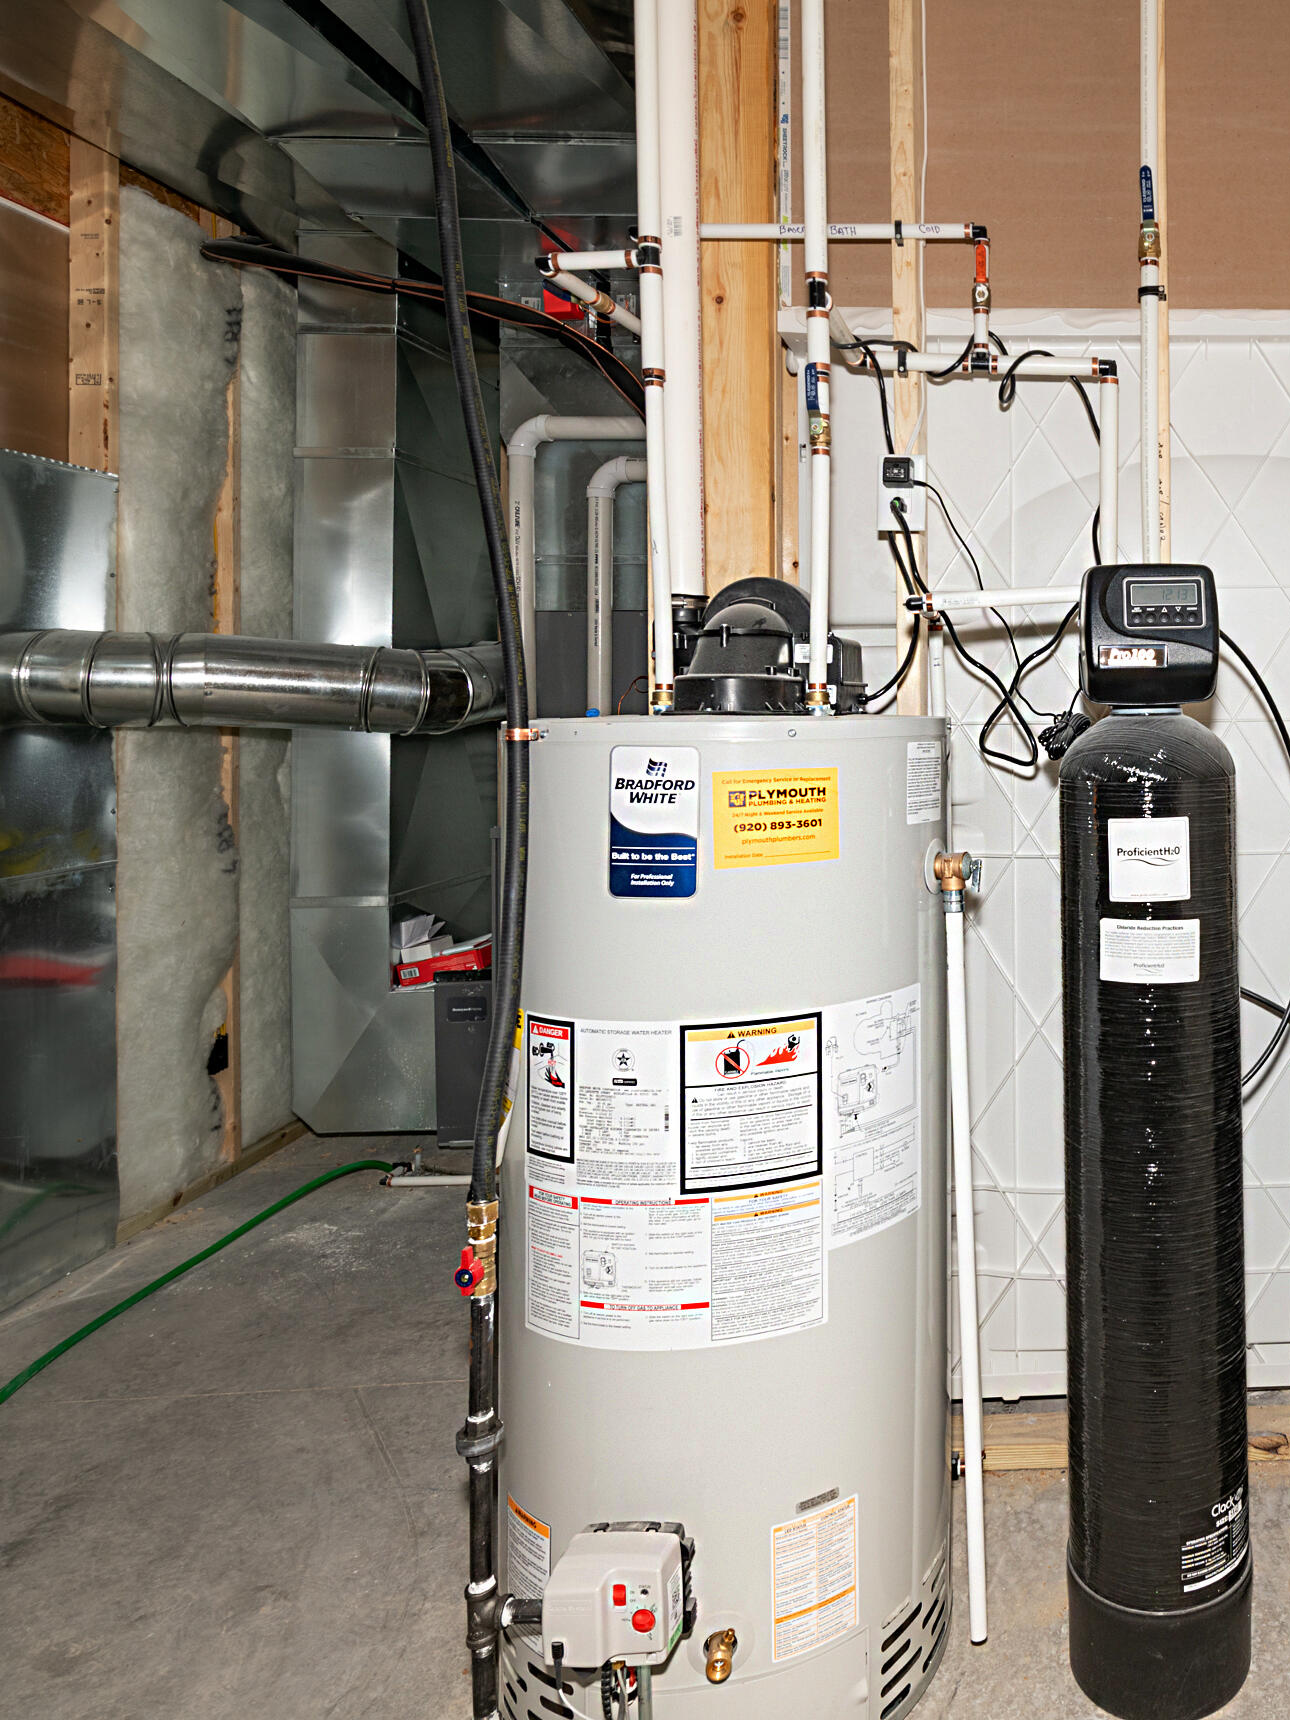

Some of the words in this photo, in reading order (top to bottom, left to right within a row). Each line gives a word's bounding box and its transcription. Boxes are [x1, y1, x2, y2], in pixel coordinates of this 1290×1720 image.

[830, 225, 857, 236] BATH
[615, 777, 695, 791] BRADFORD
[629, 791, 677, 804] WHITE
[748, 787, 827, 800] PLYMOUTH
[748, 799, 788, 807] PLUMBING
[796, 796, 827, 804] HEATING
[734, 822, 767, 833] (920)
[770, 818, 822, 830] 893-3601
[741, 834, 816, 845] plymouthplumbers.com
[611, 852, 629, 860] Built
[631, 852, 640, 860] to
[641, 852, 653, 860] be
[655, 852, 669, 860] the
[538, 1026, 564, 1037] DANGER
[737, 1027, 777, 1038] WARNING
[738, 1082, 766, 1090] EXPLOSION
[1211, 1495, 1236, 1518] Clack
